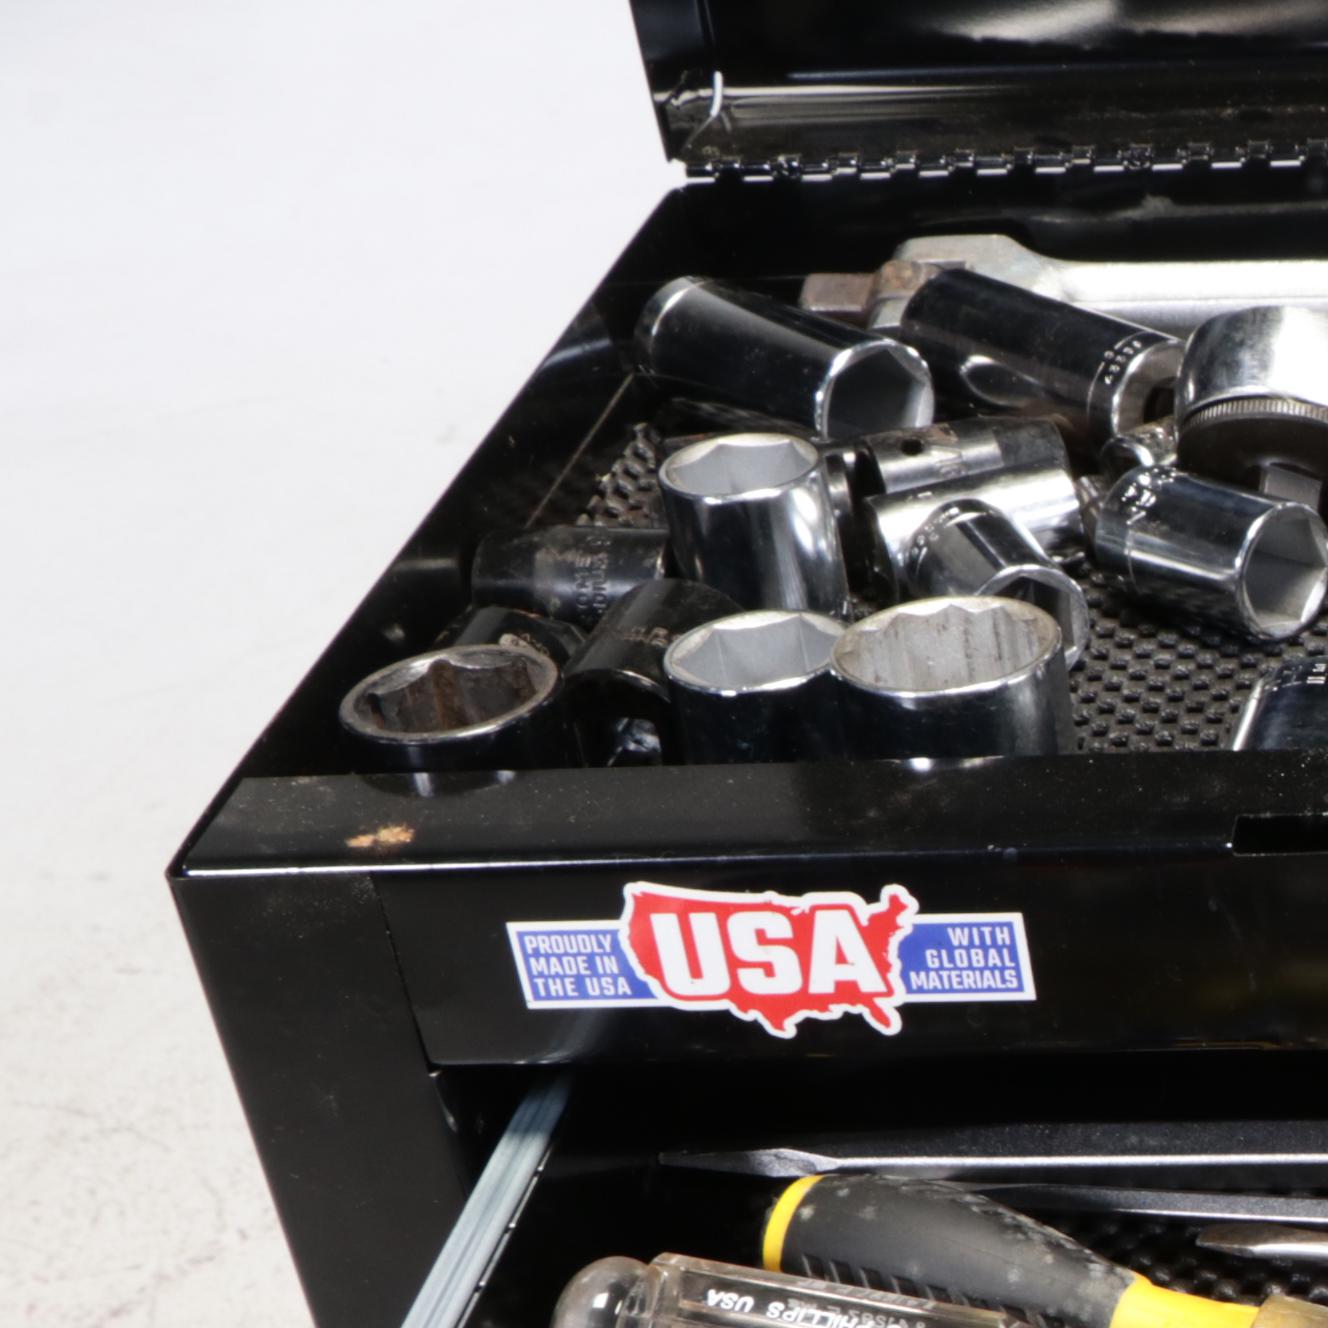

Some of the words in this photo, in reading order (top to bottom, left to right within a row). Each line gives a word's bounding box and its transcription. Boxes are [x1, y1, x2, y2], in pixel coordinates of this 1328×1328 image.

[524, 932, 612, 954] PROUDLY
[947, 926, 1011, 946] WITH
[529, 953, 593, 976] MADE
[594, 954, 619, 976] IN
[650, 908, 887, 999] USA
[925, 947, 1016, 969] GLOBAL
[533, 976, 581, 998] THE
[586, 975, 632, 997] USA
[909, 969, 1018, 992] MATERIALS
[705, 1287, 755, 1313] USA
